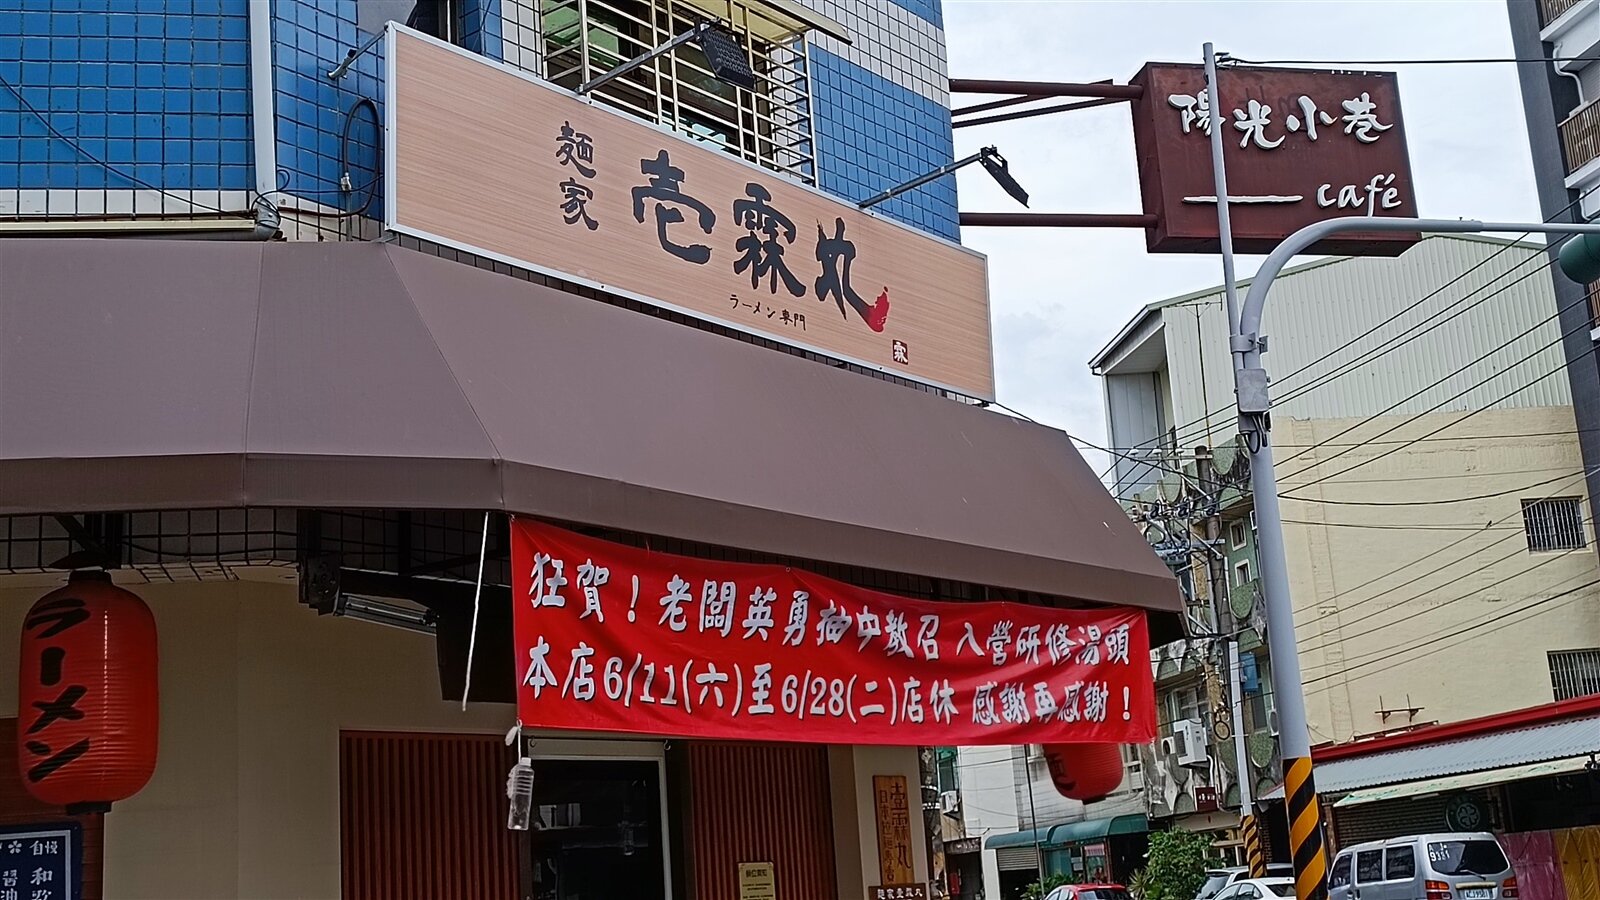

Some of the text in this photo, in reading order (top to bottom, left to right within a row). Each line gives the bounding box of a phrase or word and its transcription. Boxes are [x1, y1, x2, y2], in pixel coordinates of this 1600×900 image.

[1168, 89, 1394, 150] 陽光小巷
[1317, 173, 1402, 217] café
[24, 597, 92, 784] ラーメン
